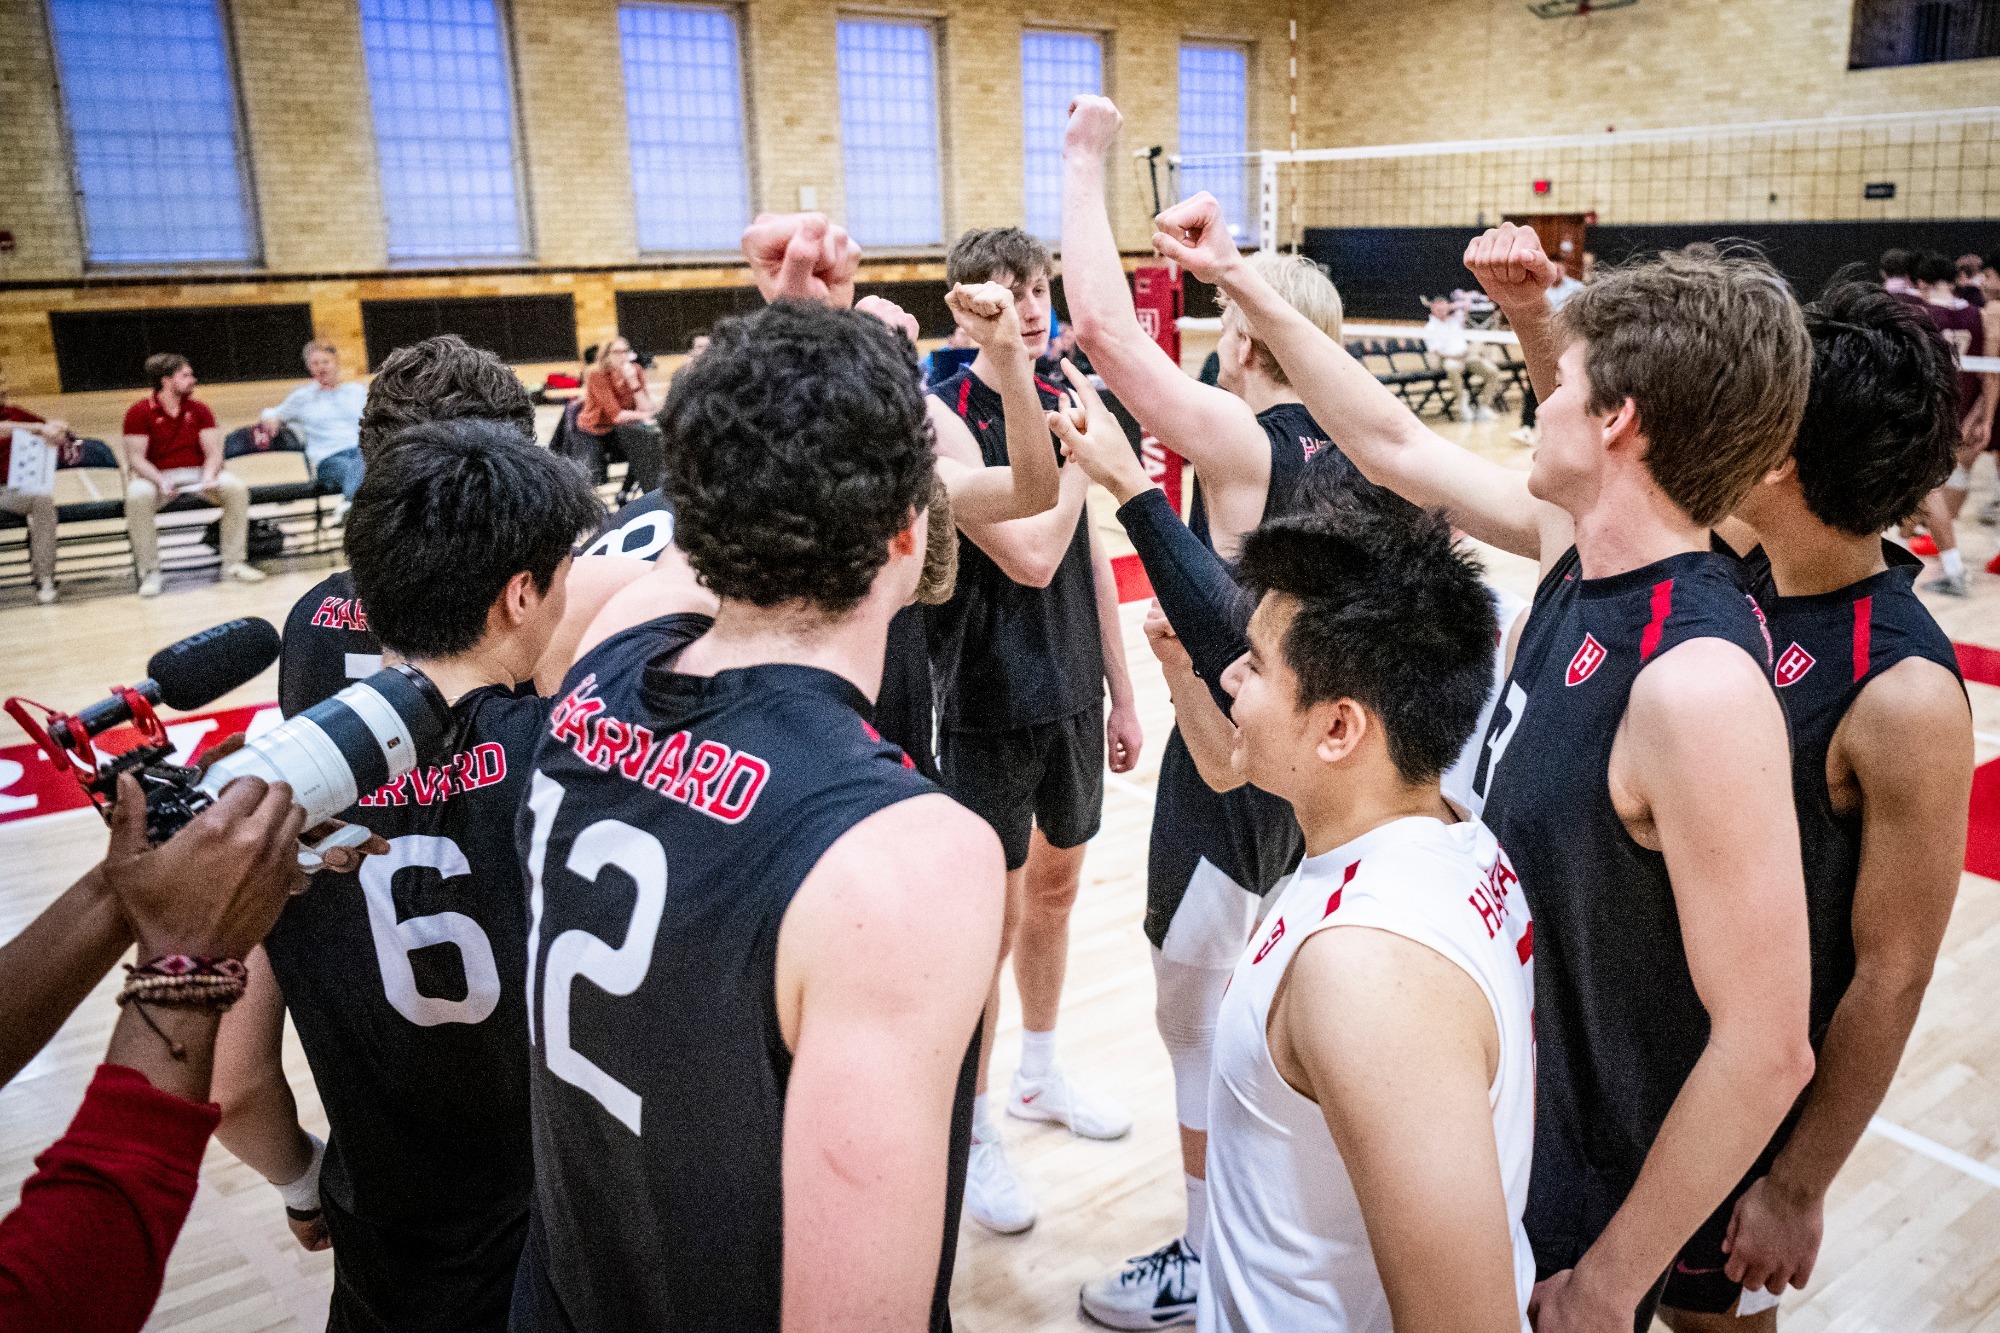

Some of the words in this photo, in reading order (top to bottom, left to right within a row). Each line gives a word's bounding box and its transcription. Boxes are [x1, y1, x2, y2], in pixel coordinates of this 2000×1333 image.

[1573, 643, 1600, 677] H
[1779, 650, 1807, 680] H
[551, 673, 770, 824] HARVARD
[358, 834, 500, 1027] 6
[526, 768, 668, 1137] 12
